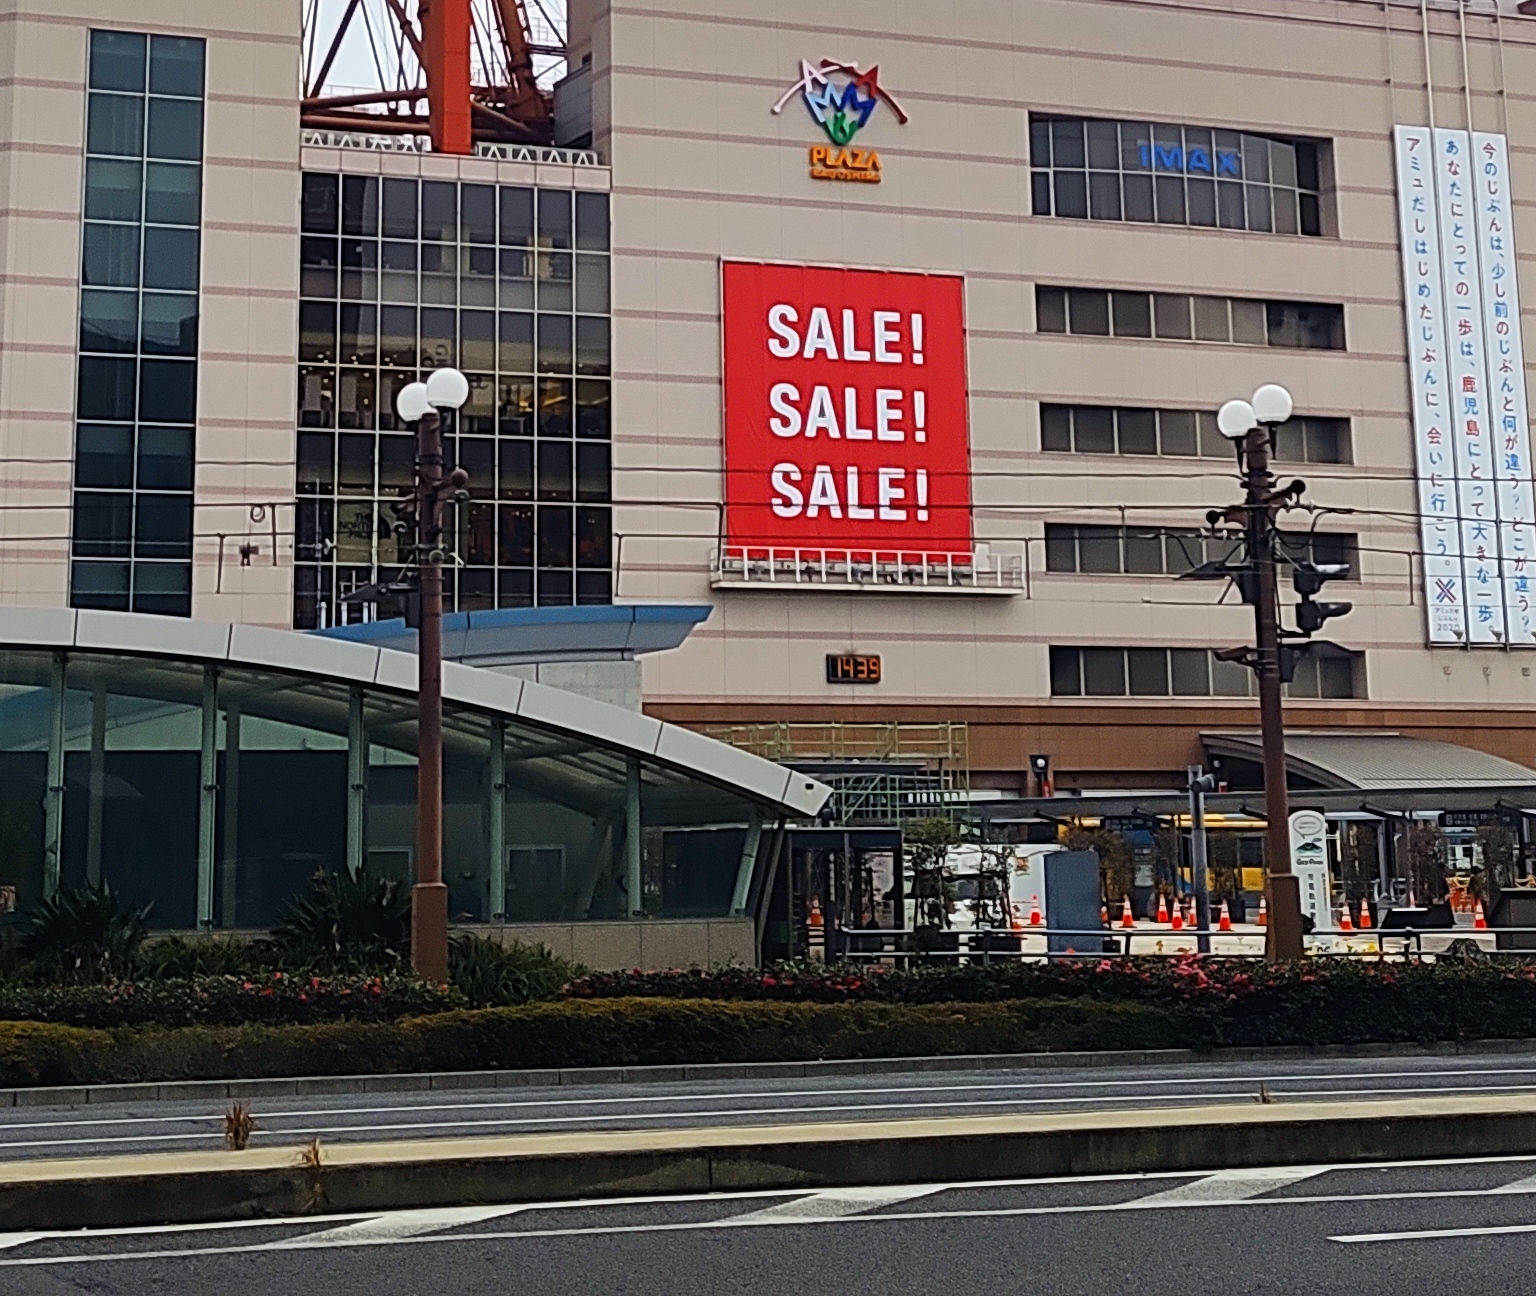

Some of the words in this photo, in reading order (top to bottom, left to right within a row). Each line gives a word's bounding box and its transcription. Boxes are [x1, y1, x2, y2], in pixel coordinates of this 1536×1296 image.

[810, 146, 881, 171] PLAZA
[1138, 144, 1237, 176] IMAX
[767, 303, 924, 366] SALE!
[769, 383, 927, 444] SALE!
[770, 461, 930, 522] SALE!
